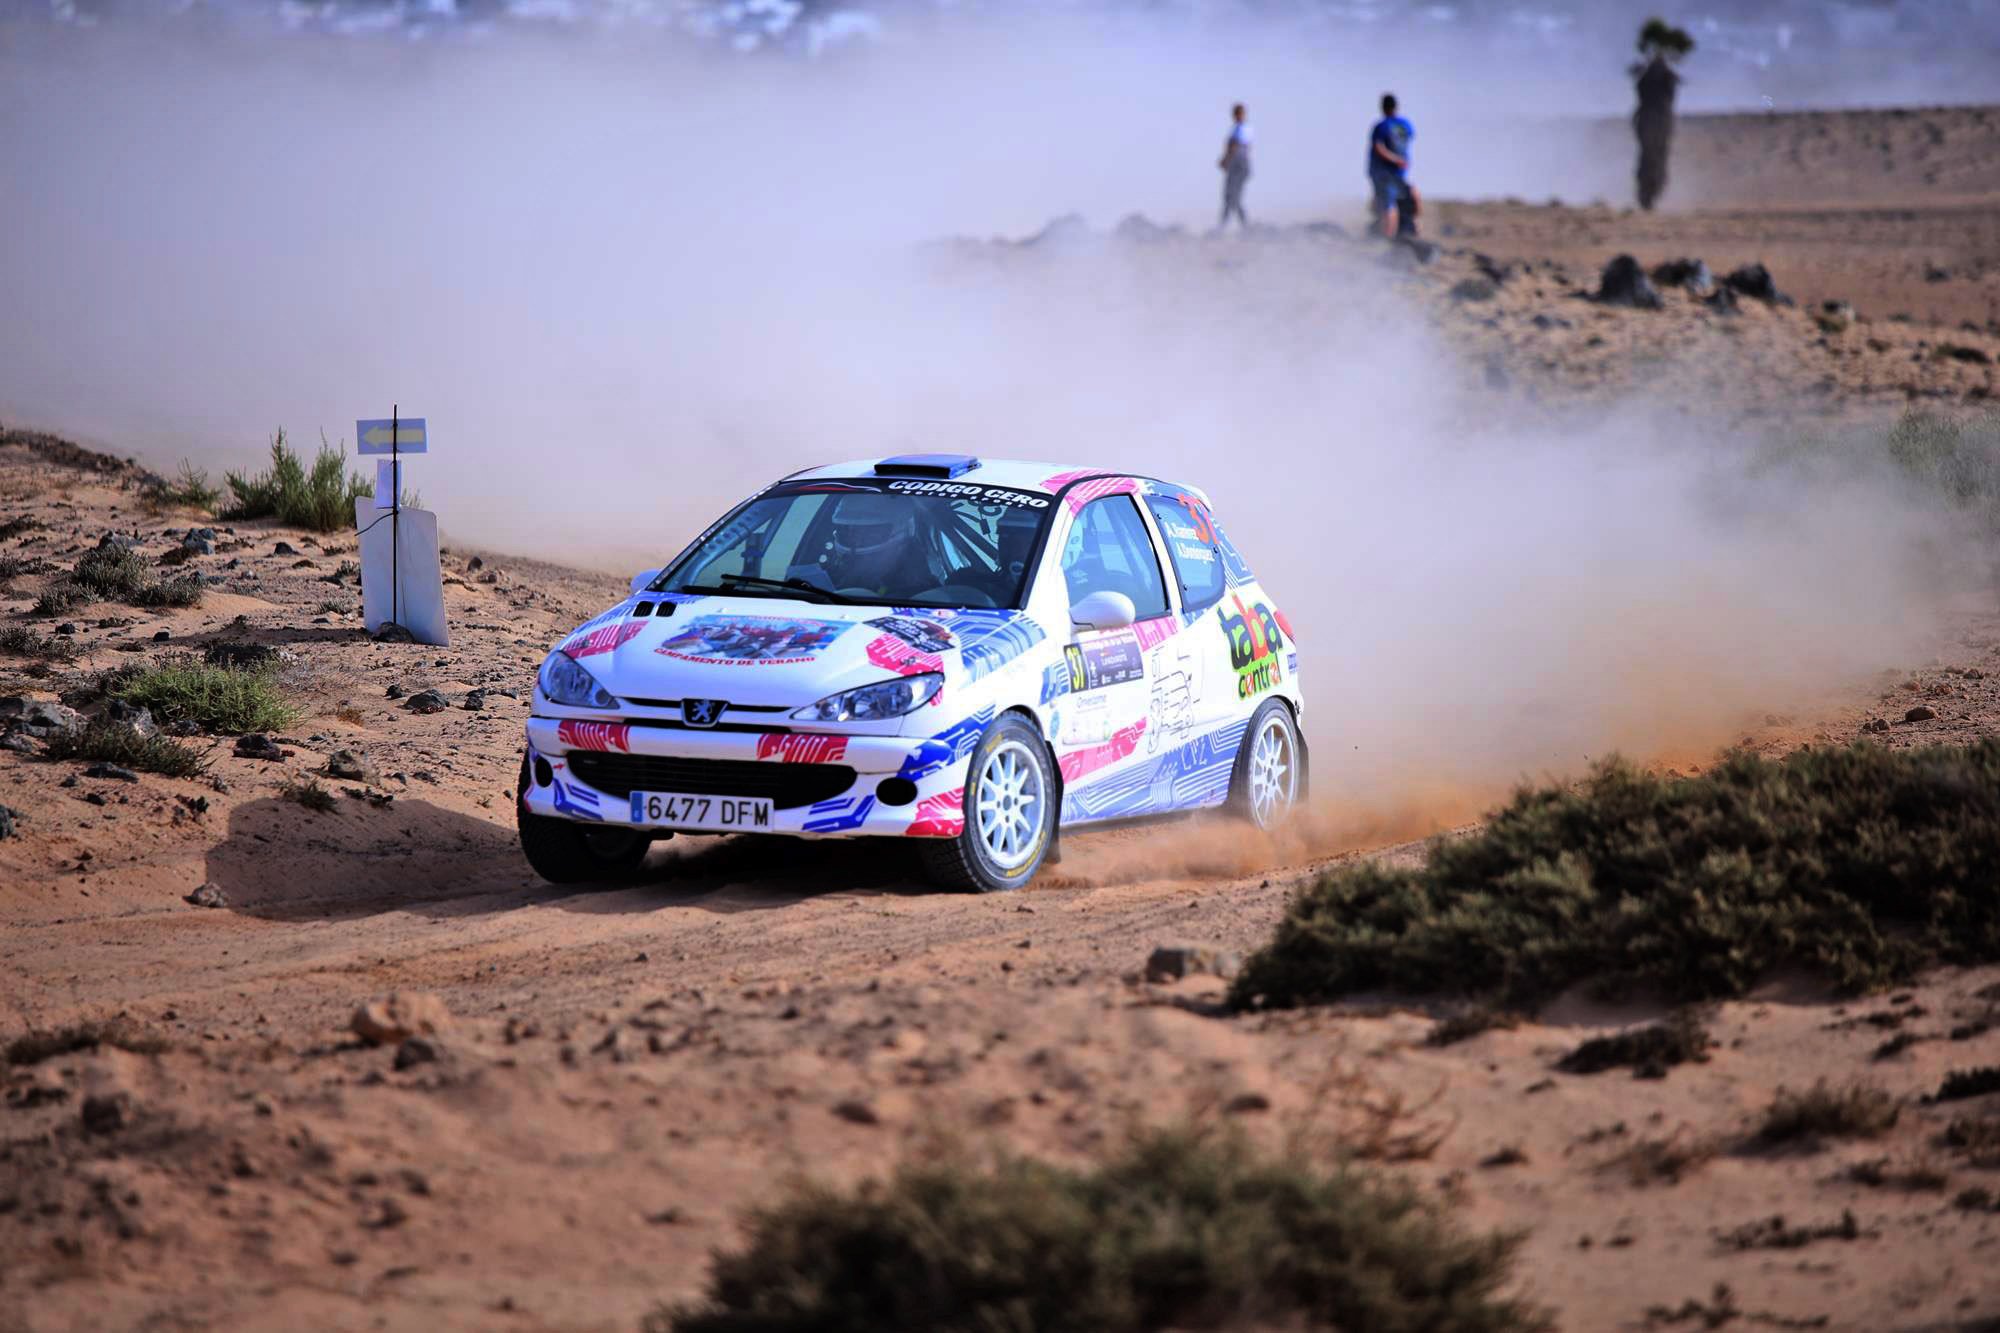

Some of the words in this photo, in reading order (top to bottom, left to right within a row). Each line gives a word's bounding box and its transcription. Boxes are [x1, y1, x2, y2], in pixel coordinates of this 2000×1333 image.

[888, 480, 983, 496] CODIGO
[985, 489, 1049, 508] CERO
[1217, 591, 1284, 671] taba
[654, 647, 736, 666] CAMPAMENTO
[736, 658, 755, 666] DE
[759, 656, 816, 665] VERANO
[1066, 646, 1085, 690] 37
[1238, 652, 1282, 699] central
[648, 796, 712, 823] 6477
[721, 800, 768, 826] DFM
